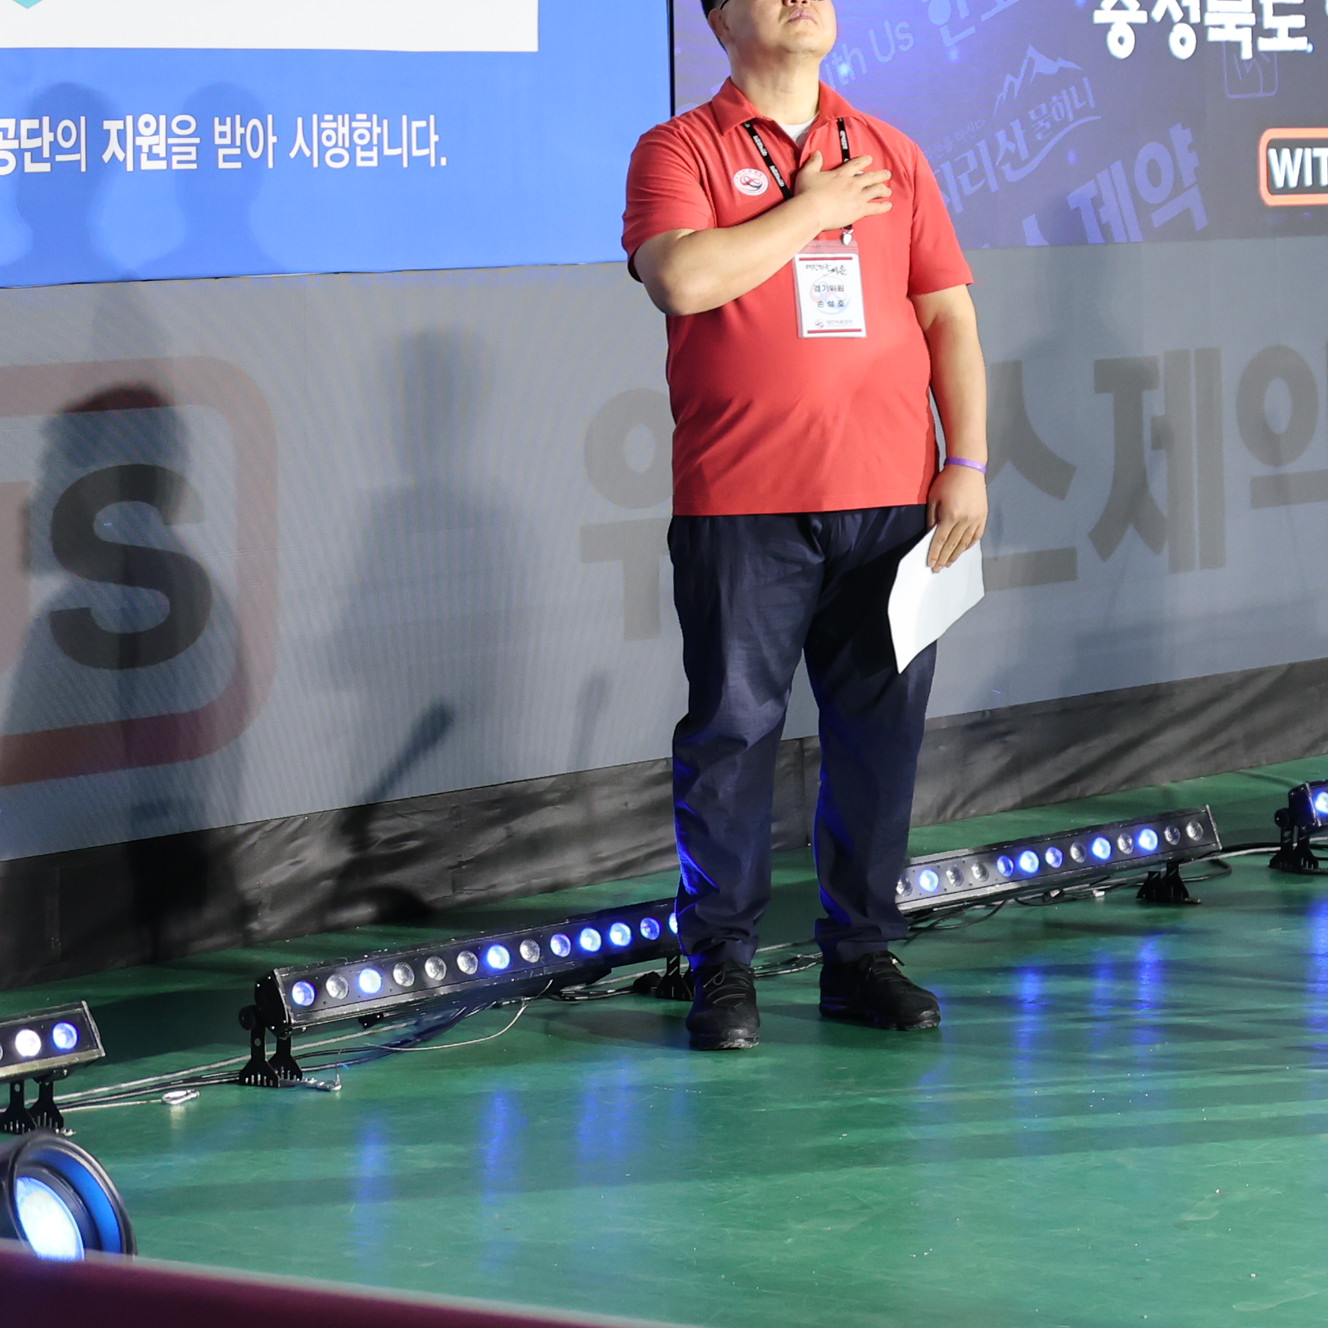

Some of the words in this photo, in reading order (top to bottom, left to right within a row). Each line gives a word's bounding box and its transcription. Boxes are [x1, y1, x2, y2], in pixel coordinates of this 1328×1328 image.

[101, 113, 201, 172] 지원을
[213, 115, 278, 170] 받아
[289, 114, 448, 169] 시행합니다.
